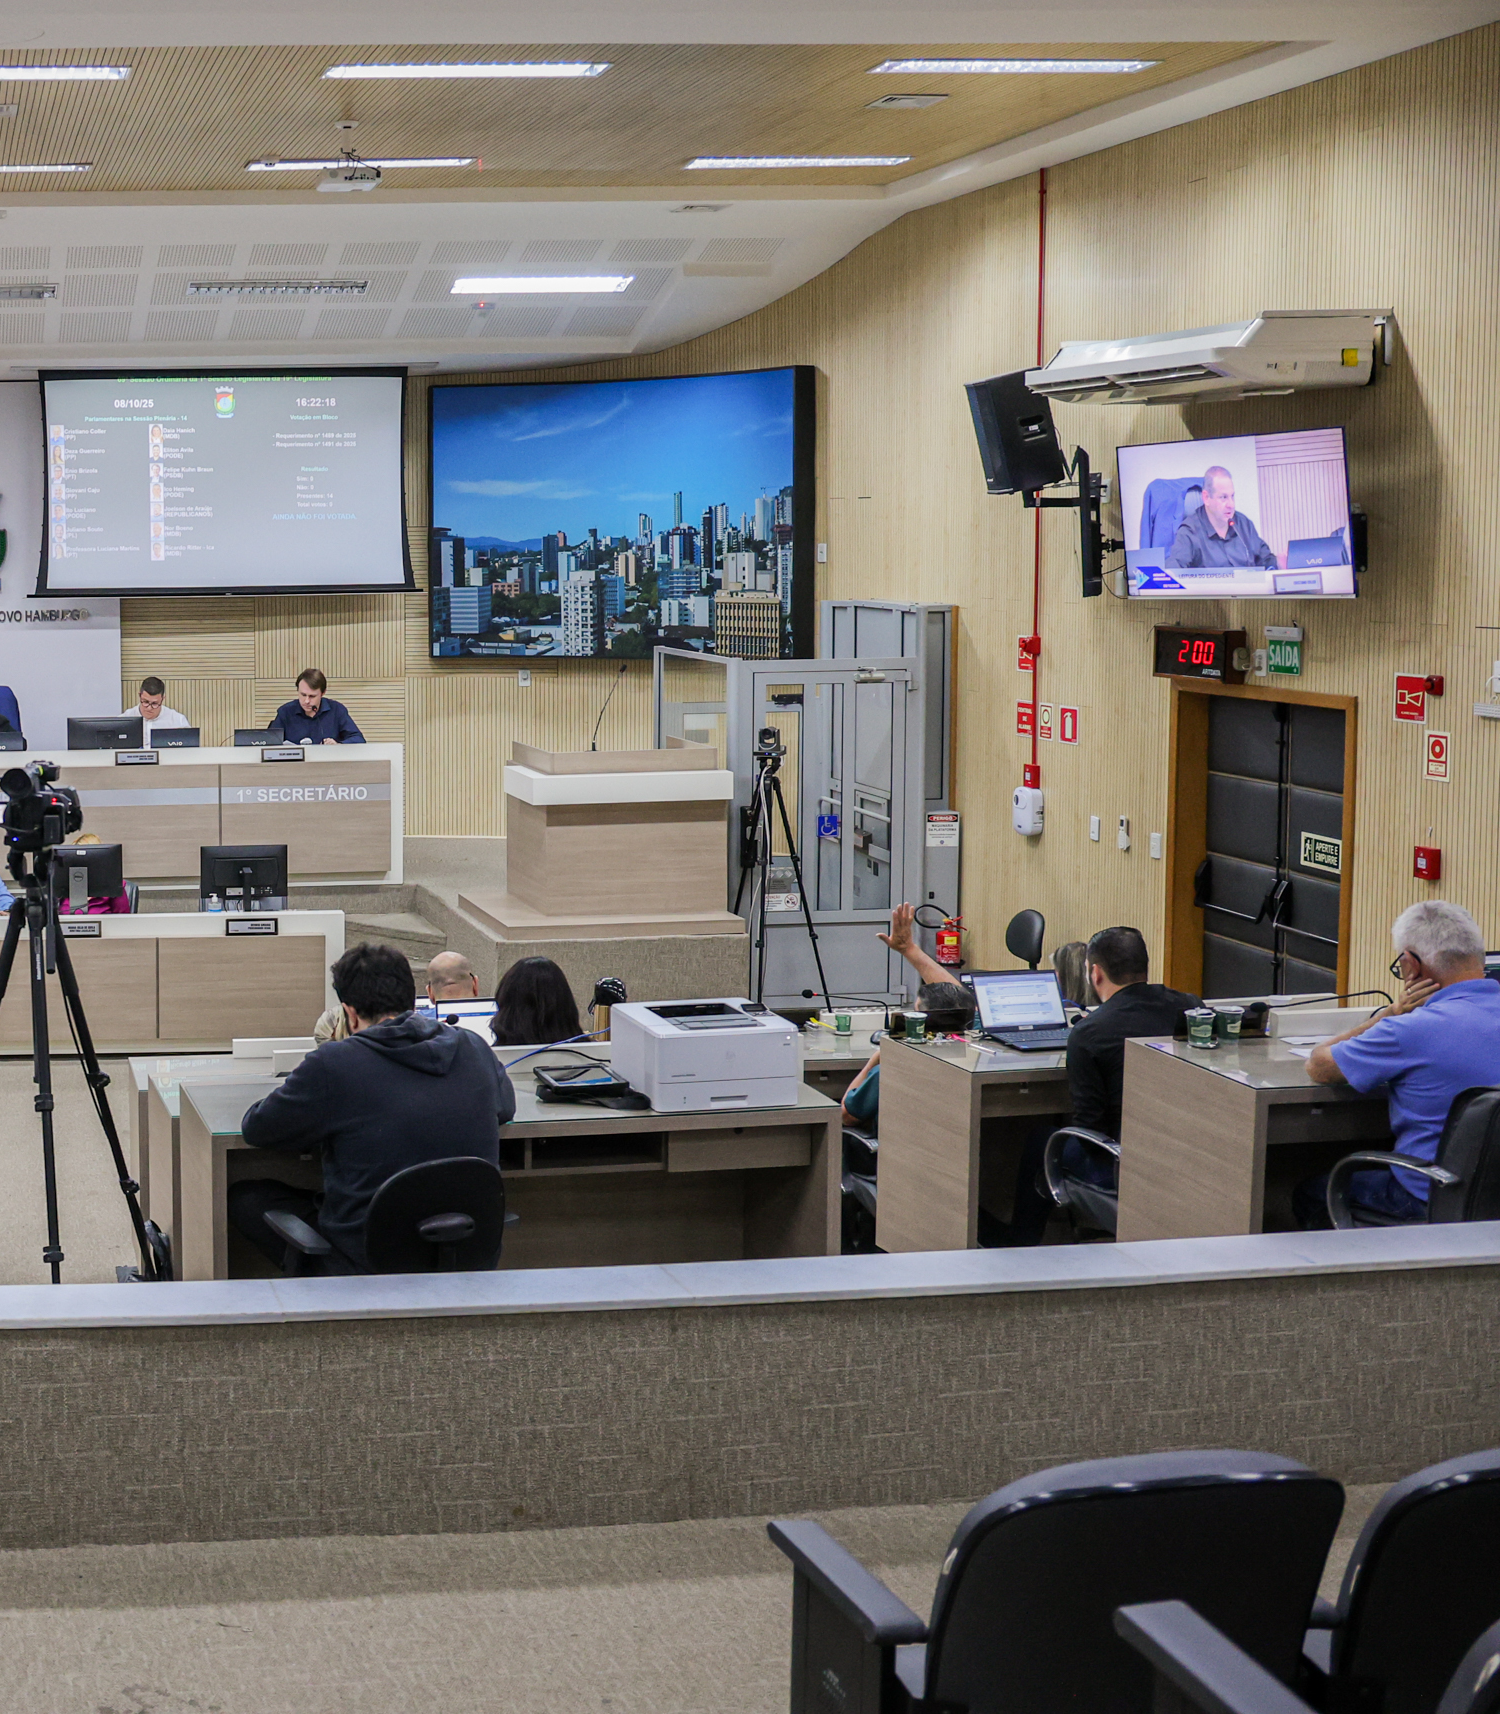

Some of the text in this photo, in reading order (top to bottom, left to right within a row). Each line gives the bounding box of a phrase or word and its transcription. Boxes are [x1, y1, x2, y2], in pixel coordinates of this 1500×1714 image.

[114, 399, 154, 408] 08/10/25
[296, 398, 336, 407] 16:22:18
[26, 609, 90, 623] HAMBURGO
[1269, 640, 1299, 667] SAÍDA
[257, 785, 368, 802] SECRETÁRIO
[1315, 842, 1338, 855] APERTE E
[1315, 853, 1338, 866] EMPURRE
